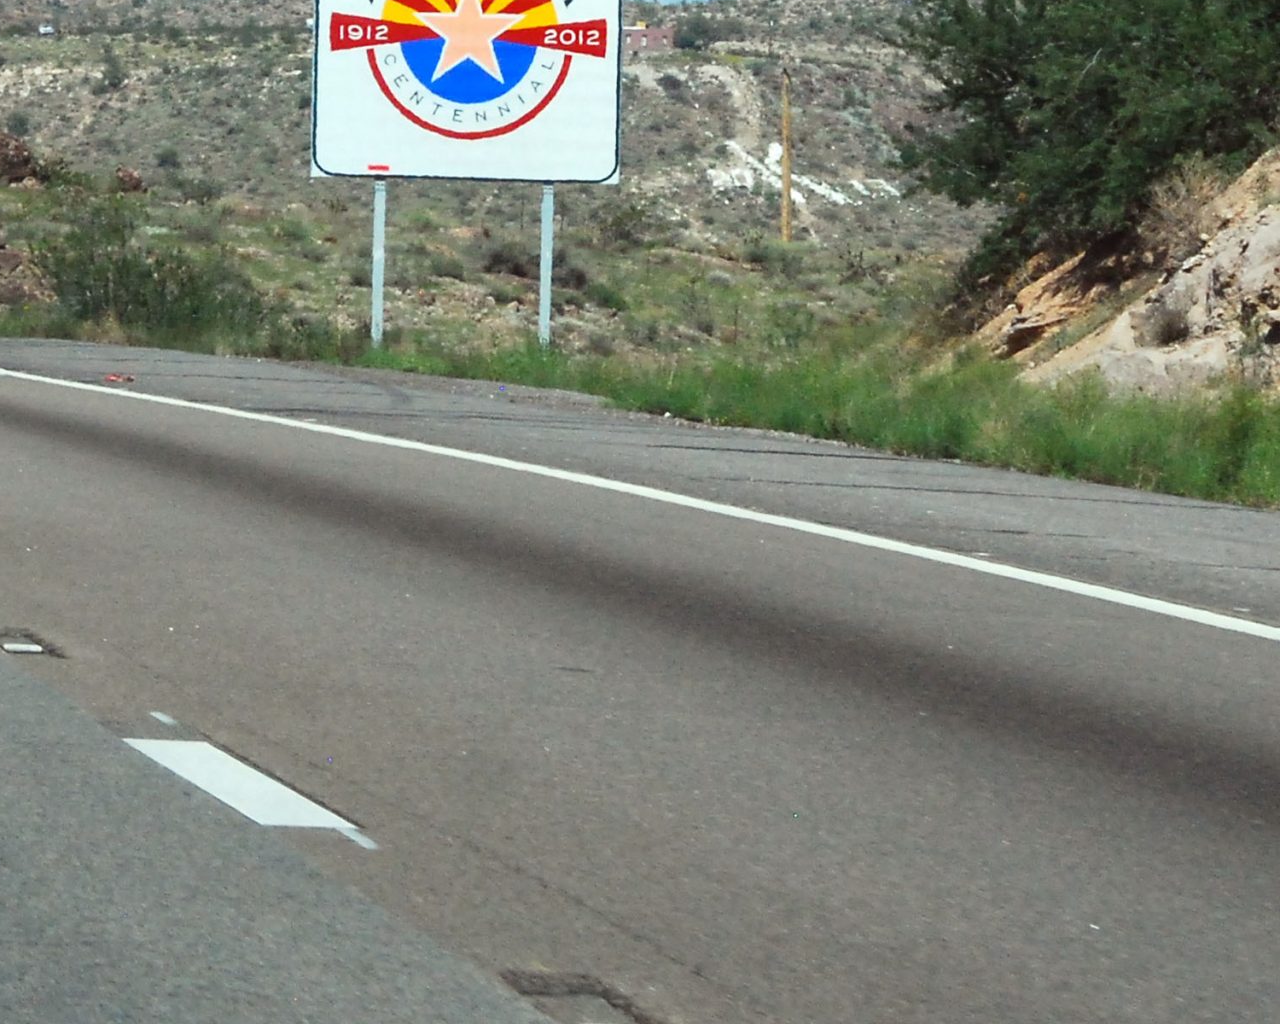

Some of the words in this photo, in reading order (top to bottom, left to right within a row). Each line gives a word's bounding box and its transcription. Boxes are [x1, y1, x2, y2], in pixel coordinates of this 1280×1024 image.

[338, 24, 389, 41] 1912
[543, 28, 600, 46] 2012
[383, 52, 555, 123] CENTENNIAL
